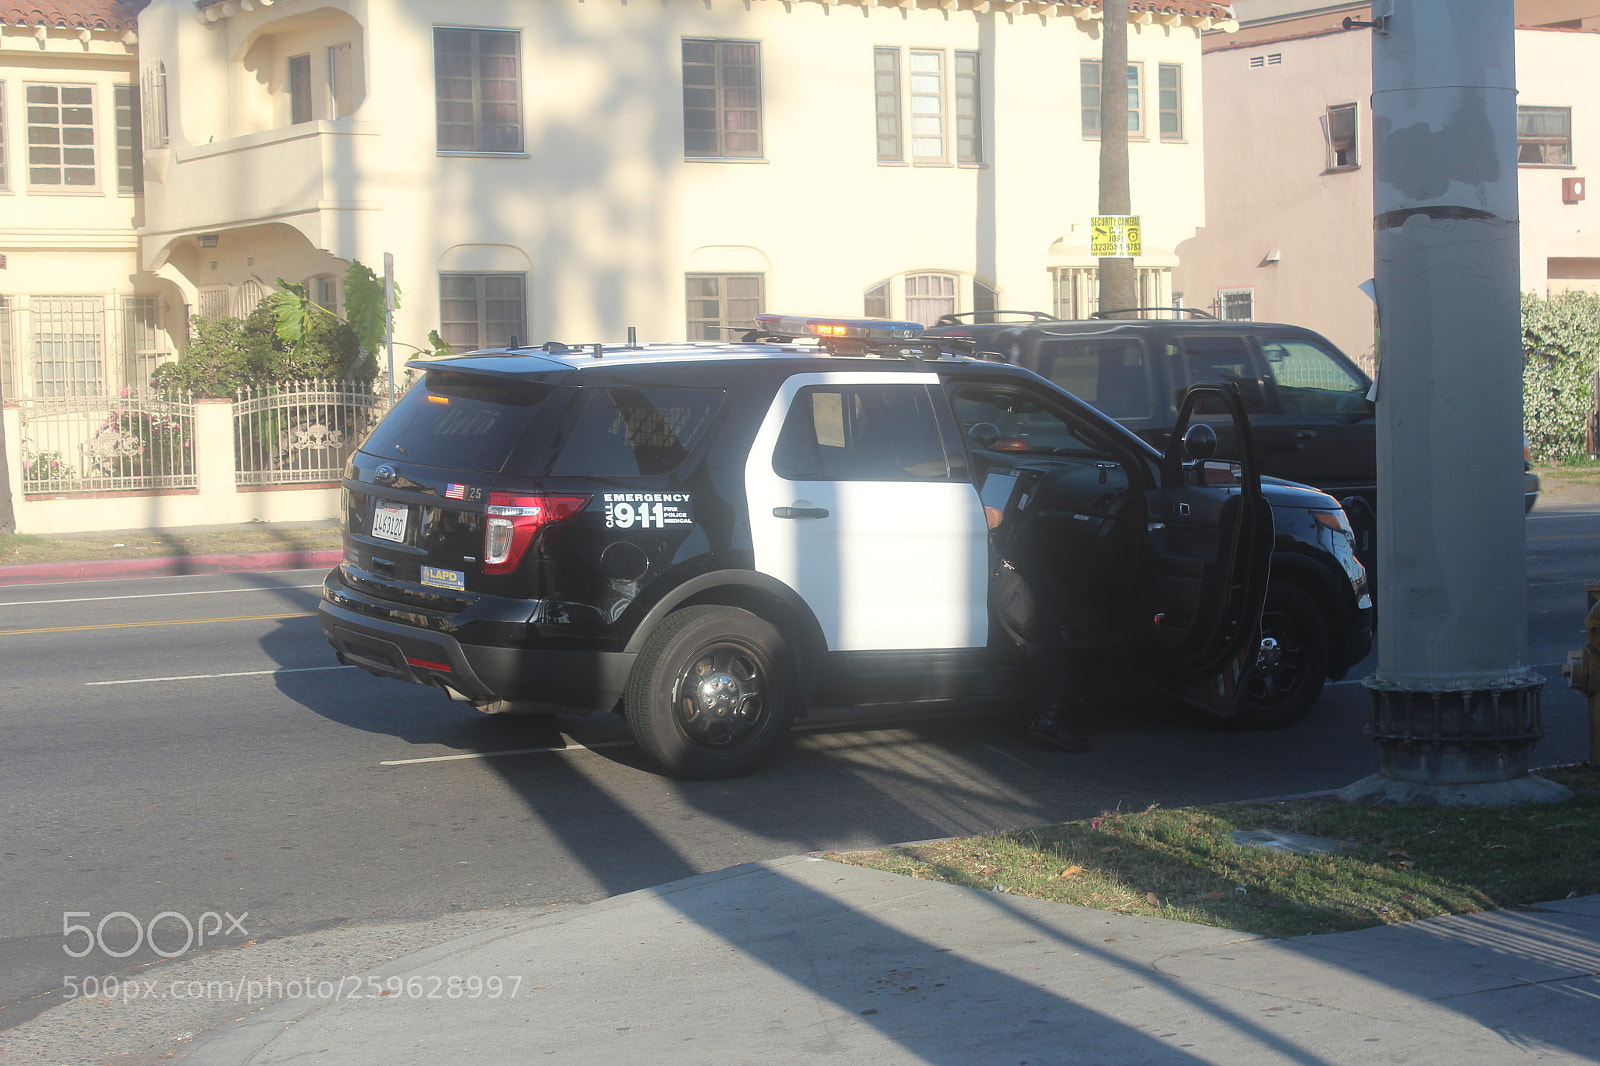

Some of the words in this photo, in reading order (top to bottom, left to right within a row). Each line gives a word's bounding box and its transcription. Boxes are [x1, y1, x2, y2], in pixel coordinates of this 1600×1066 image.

[1091, 217, 1116, 226] SECURITY
[470, 487, 482, 499] 25
[604, 494, 690, 502] EMERGENCY
[605, 502, 614, 528] CALL
[430, 568, 458, 582] LAPD
